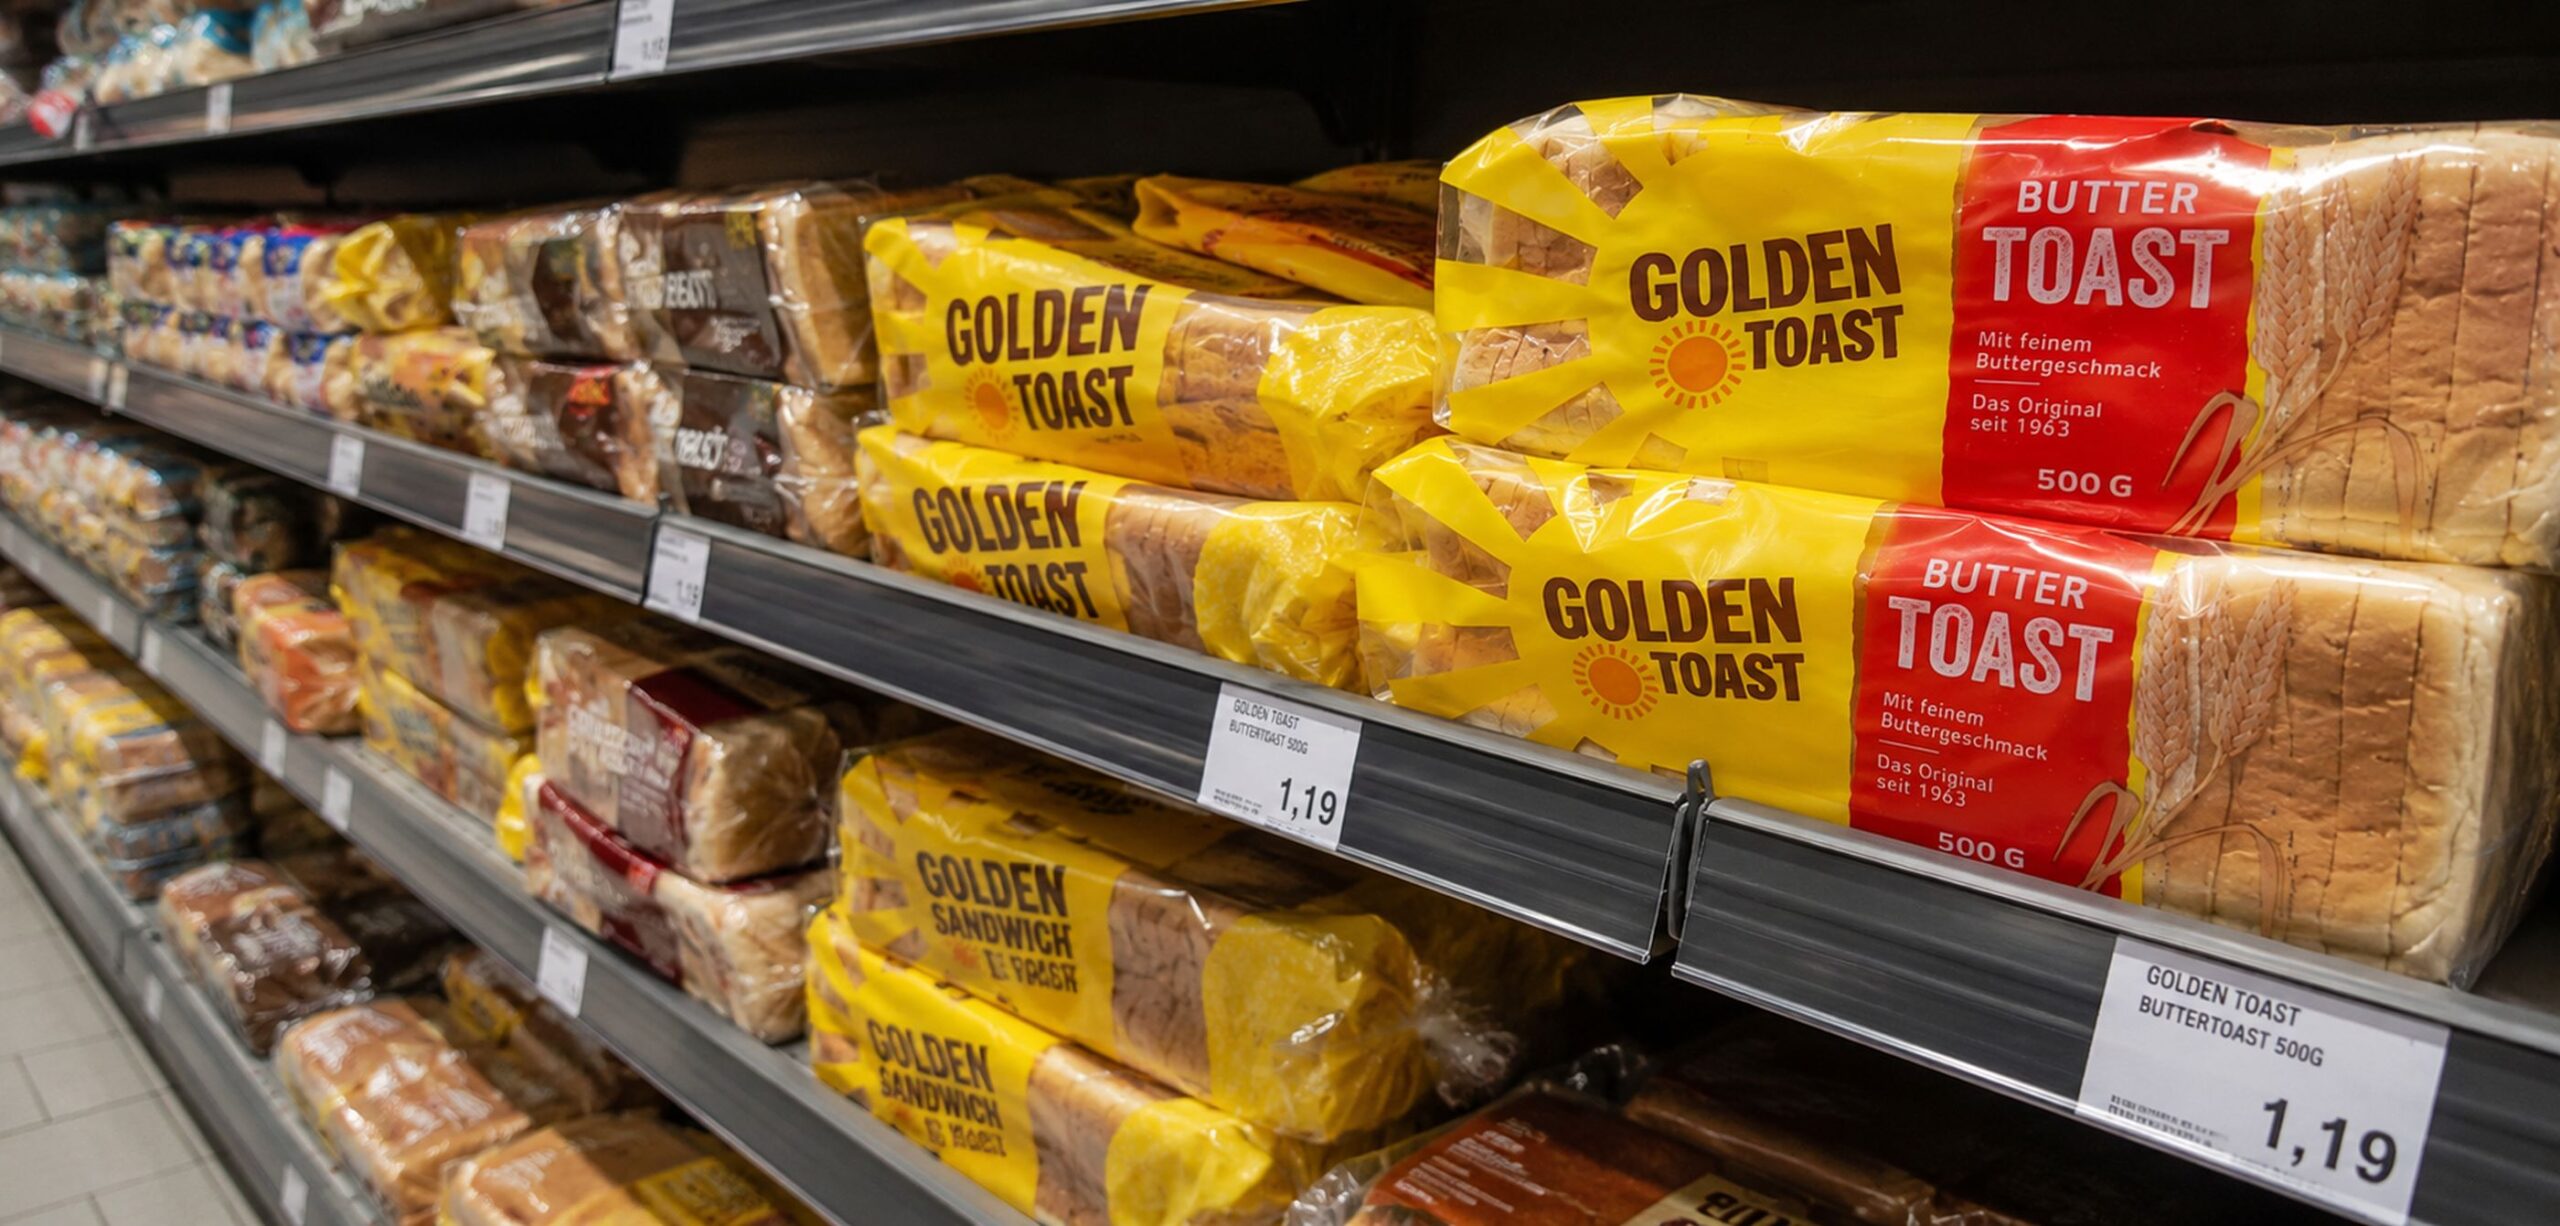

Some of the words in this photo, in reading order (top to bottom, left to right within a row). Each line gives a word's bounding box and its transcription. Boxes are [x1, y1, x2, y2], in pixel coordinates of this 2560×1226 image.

[2017, 180, 2199, 214] BUTTER
[1629, 223, 1902, 322] GOLDEN
[1982, 226, 2230, 309] TOAST
[946, 283, 1154, 366] GOLDEN
[1744, 304, 1904, 370] TOAST
[1978, 331, 2012, 349] Mit
[2020, 332, 2092, 352] feinem
[1976, 352, 2162, 378] Buttergeschmack
[1012, 365, 1134, 431] TOAST
[1972, 393, 2011, 412] Das
[2018, 396, 2102, 420] Original
[1970, 415, 2008, 433] seit
[2018, 418, 2070, 437] 1963
[2037, 468, 2101, 495] 500
[2109, 475, 2133, 498] G
[913, 480, 1088, 554] GOLDEN
[984, 561, 1099, 619] TOAST
[1923, 558, 2088, 609] BUTTER
[1542, 577, 1803, 644] GOLDEN
[1888, 595, 2114, 702] TOAST
[1649, 651, 1805, 702] TOAST
[1233, 699, 1269, 721] GOLDEN
[1271, 710, 1300, 730] TOAST
[1883, 692, 1914, 712] Mit
[1920, 699, 1984, 727] feinem
[1229, 719, 1287, 747] BUTTERTOAST
[1287, 737, 1309, 755] 500G
[1881, 712, 2048, 761] Buttergeschmack
[1876, 776, 1911, 795] seit
[1920, 783, 1966, 807] 1963
[1877, 754, 1912, 775] Das
[1919, 763, 1993, 793] Original
[1281, 777, 1337, 826] 1,19
[1938, 832, 1996, 862] 500
[2004, 848, 2025, 869] G
[917, 851, 1068, 917] GOLDEN
[932, 903, 1073, 959] SANDWICH
[2147, 965, 2229, 1005] GOLDEN
[2235, 990, 2302, 1027] TOAST
[867, 1019, 995, 1093] GOLDEN
[2139, 995, 2271, 1049] BUTTERTOAST
[2274, 1037, 2325, 1067] 500G
[880, 1066, 1004, 1130] SANDWICH
[2264, 1098, 2398, 1184] 1,19
